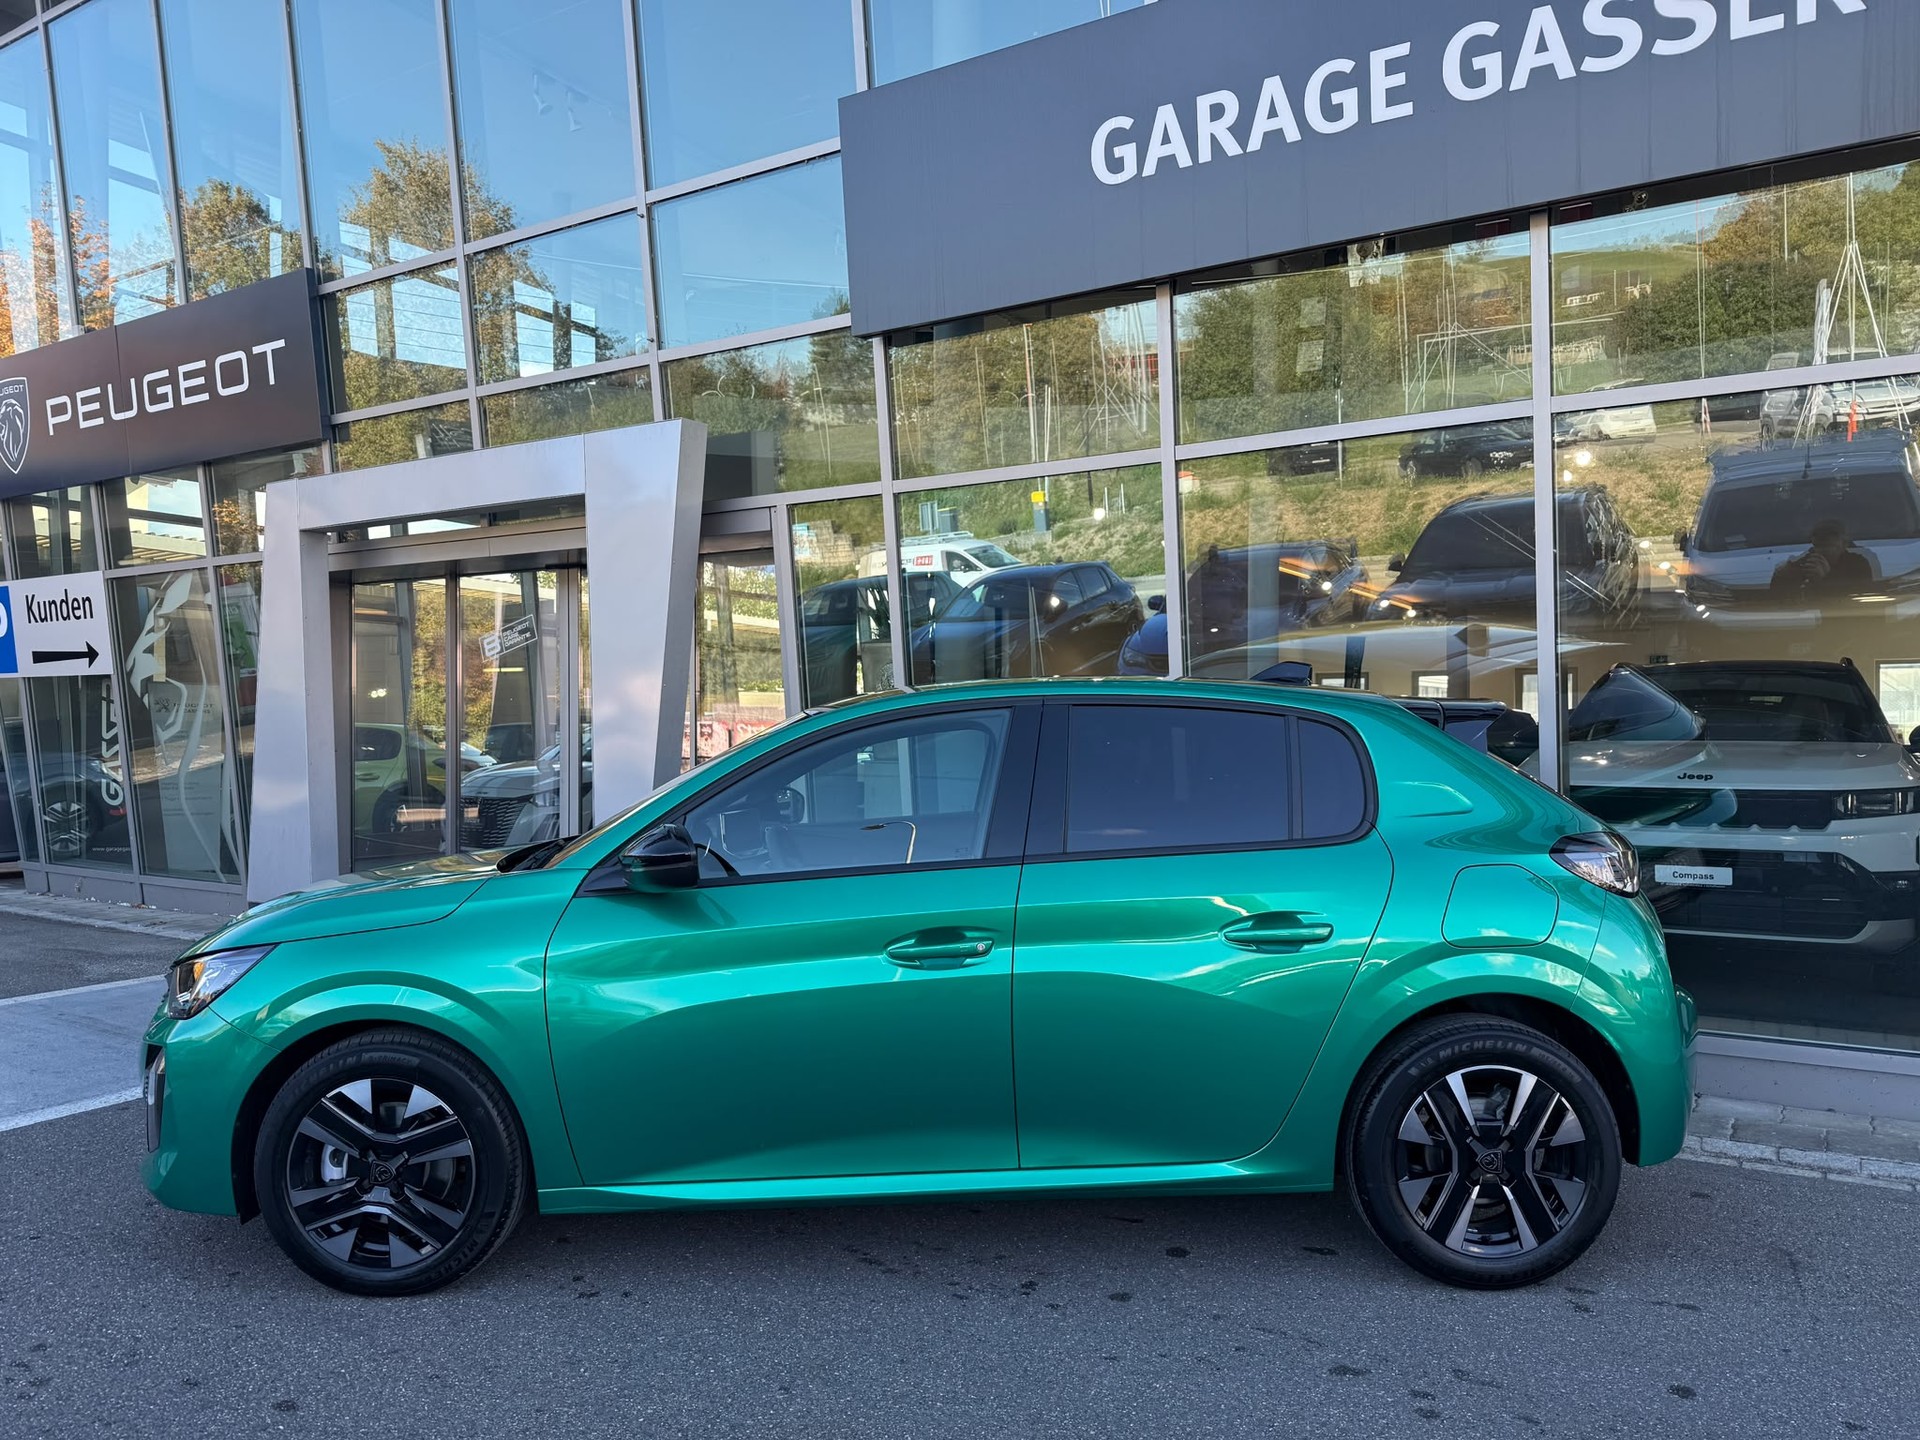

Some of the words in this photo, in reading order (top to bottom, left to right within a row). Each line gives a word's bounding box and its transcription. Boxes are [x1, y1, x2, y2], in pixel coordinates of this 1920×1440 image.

[1091, 42, 1415, 185] GARAGE
[1443, 0, 1866, 101] GASS
[46, 338, 286, 436] PEUGEOT
[25, 589, 94, 624] Kunden
[504, 621, 529, 637] PEUGEOT
[1677, 772, 1714, 782] Jeep
[1672, 870, 1714, 881] Compass
[1438, 1040, 1528, 1060] MICHELIN
